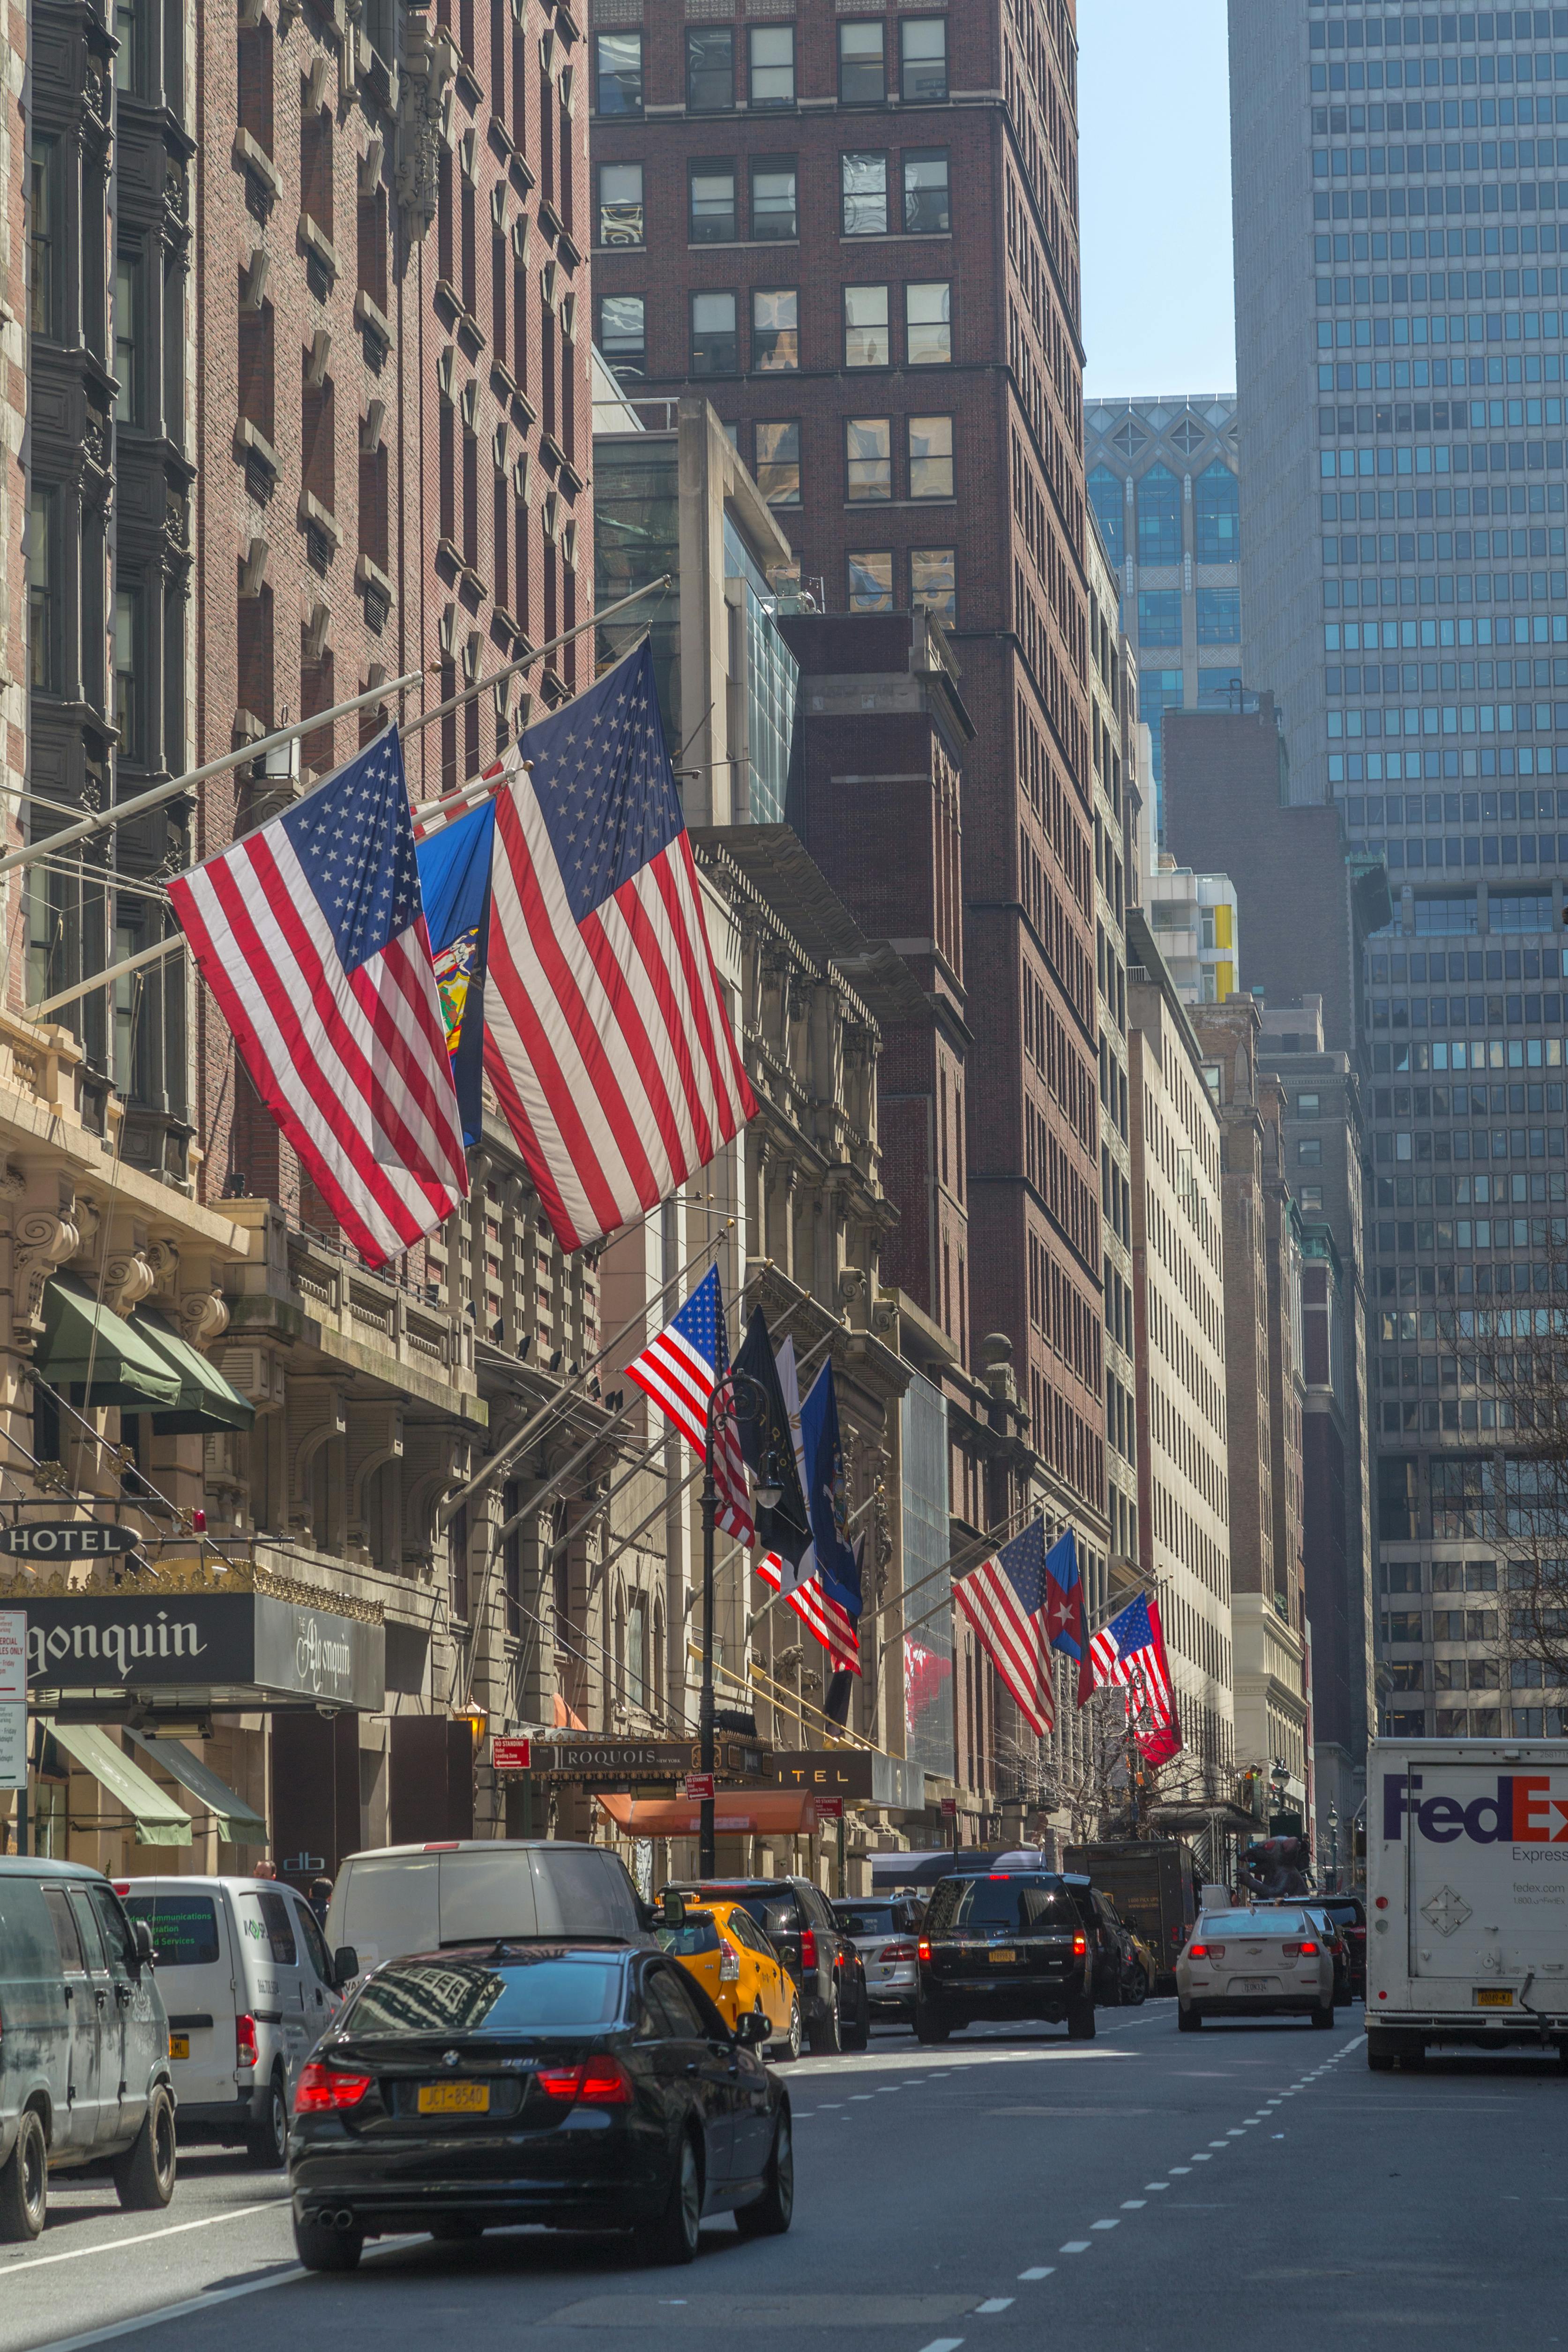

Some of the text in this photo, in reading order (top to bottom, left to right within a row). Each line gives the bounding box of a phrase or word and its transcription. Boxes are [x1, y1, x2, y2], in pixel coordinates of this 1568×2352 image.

[9, 1530, 120, 1551] HOTEL
[27, 1611, 208, 1680] gonquin
[297, 1618, 351, 1693] Algonquin
[779, 1770, 848, 1782] ITEL
[1513, 1847, 1568, 1864] Express
[1513, 1882, 1565, 1893] fedex.com
[147, 1910, 211, 1921] Communications
[151, 1925, 179, 1935] gration
